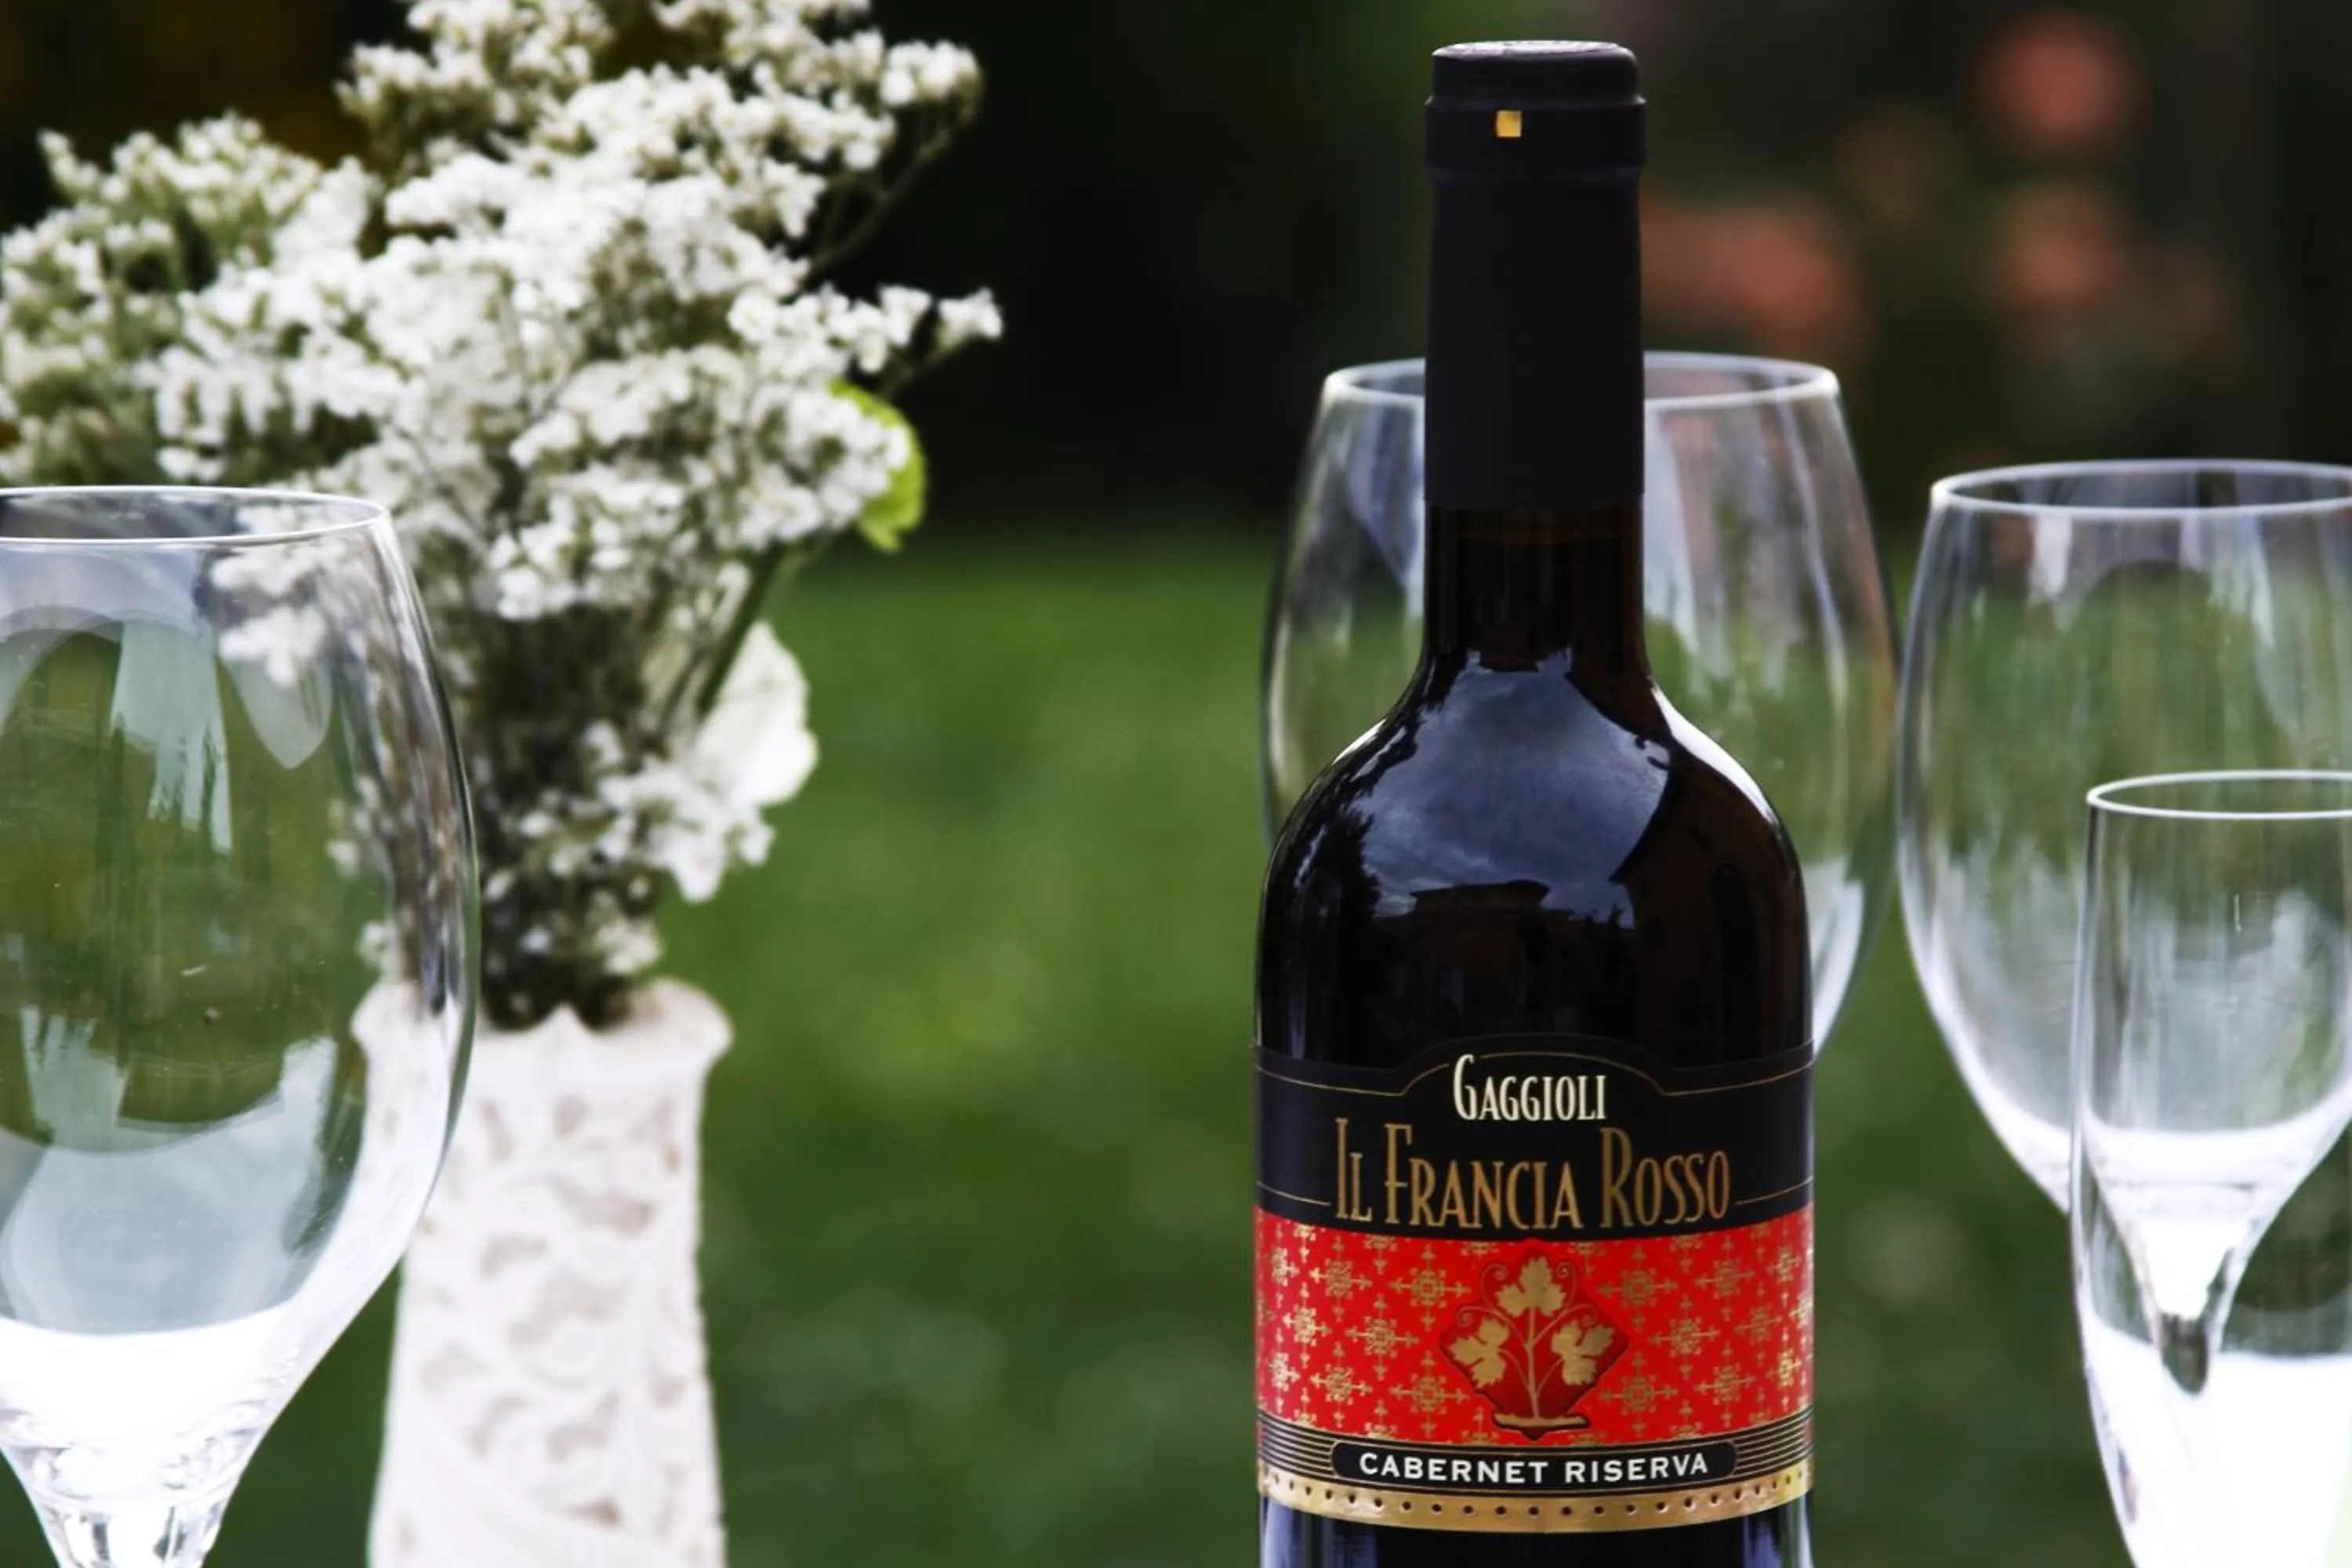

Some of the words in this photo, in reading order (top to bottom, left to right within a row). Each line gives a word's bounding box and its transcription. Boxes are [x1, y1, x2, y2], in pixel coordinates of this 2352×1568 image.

[1453, 1054, 1606, 1121] GAGGIOLI
[1335, 1118, 1372, 1223] IL
[1384, 1123, 1584, 1229] FRANCIA
[1600, 1127, 1730, 1227] ROSSO
[1359, 1452, 1549, 1483] CABERNET
[1565, 1452, 1708, 1483] RISERVA
